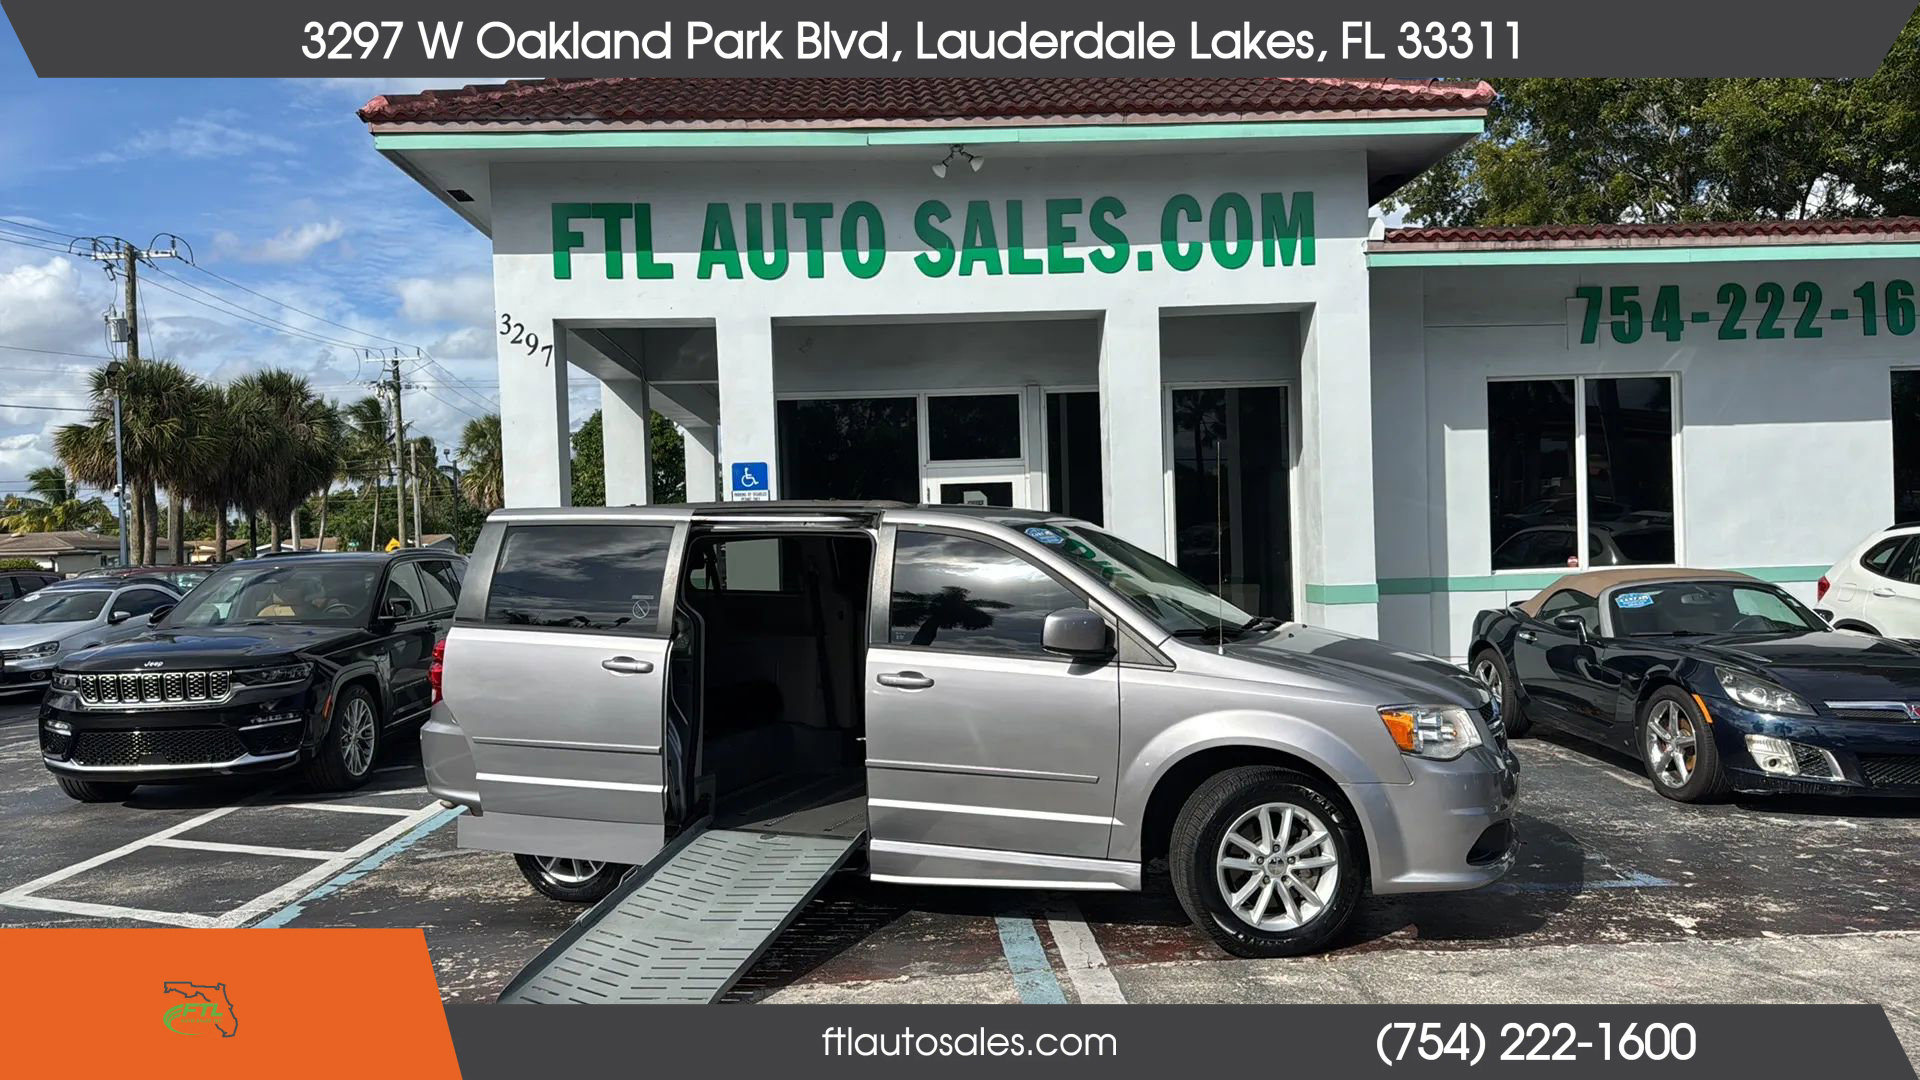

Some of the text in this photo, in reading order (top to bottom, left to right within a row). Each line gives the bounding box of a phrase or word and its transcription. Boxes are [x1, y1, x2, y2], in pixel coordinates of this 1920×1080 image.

[552, 191, 1316, 280] FTL AUTO SALES.COM
[500, 313, 553, 367] 3297
[1576, 279, 1916, 344] 754-222-16
